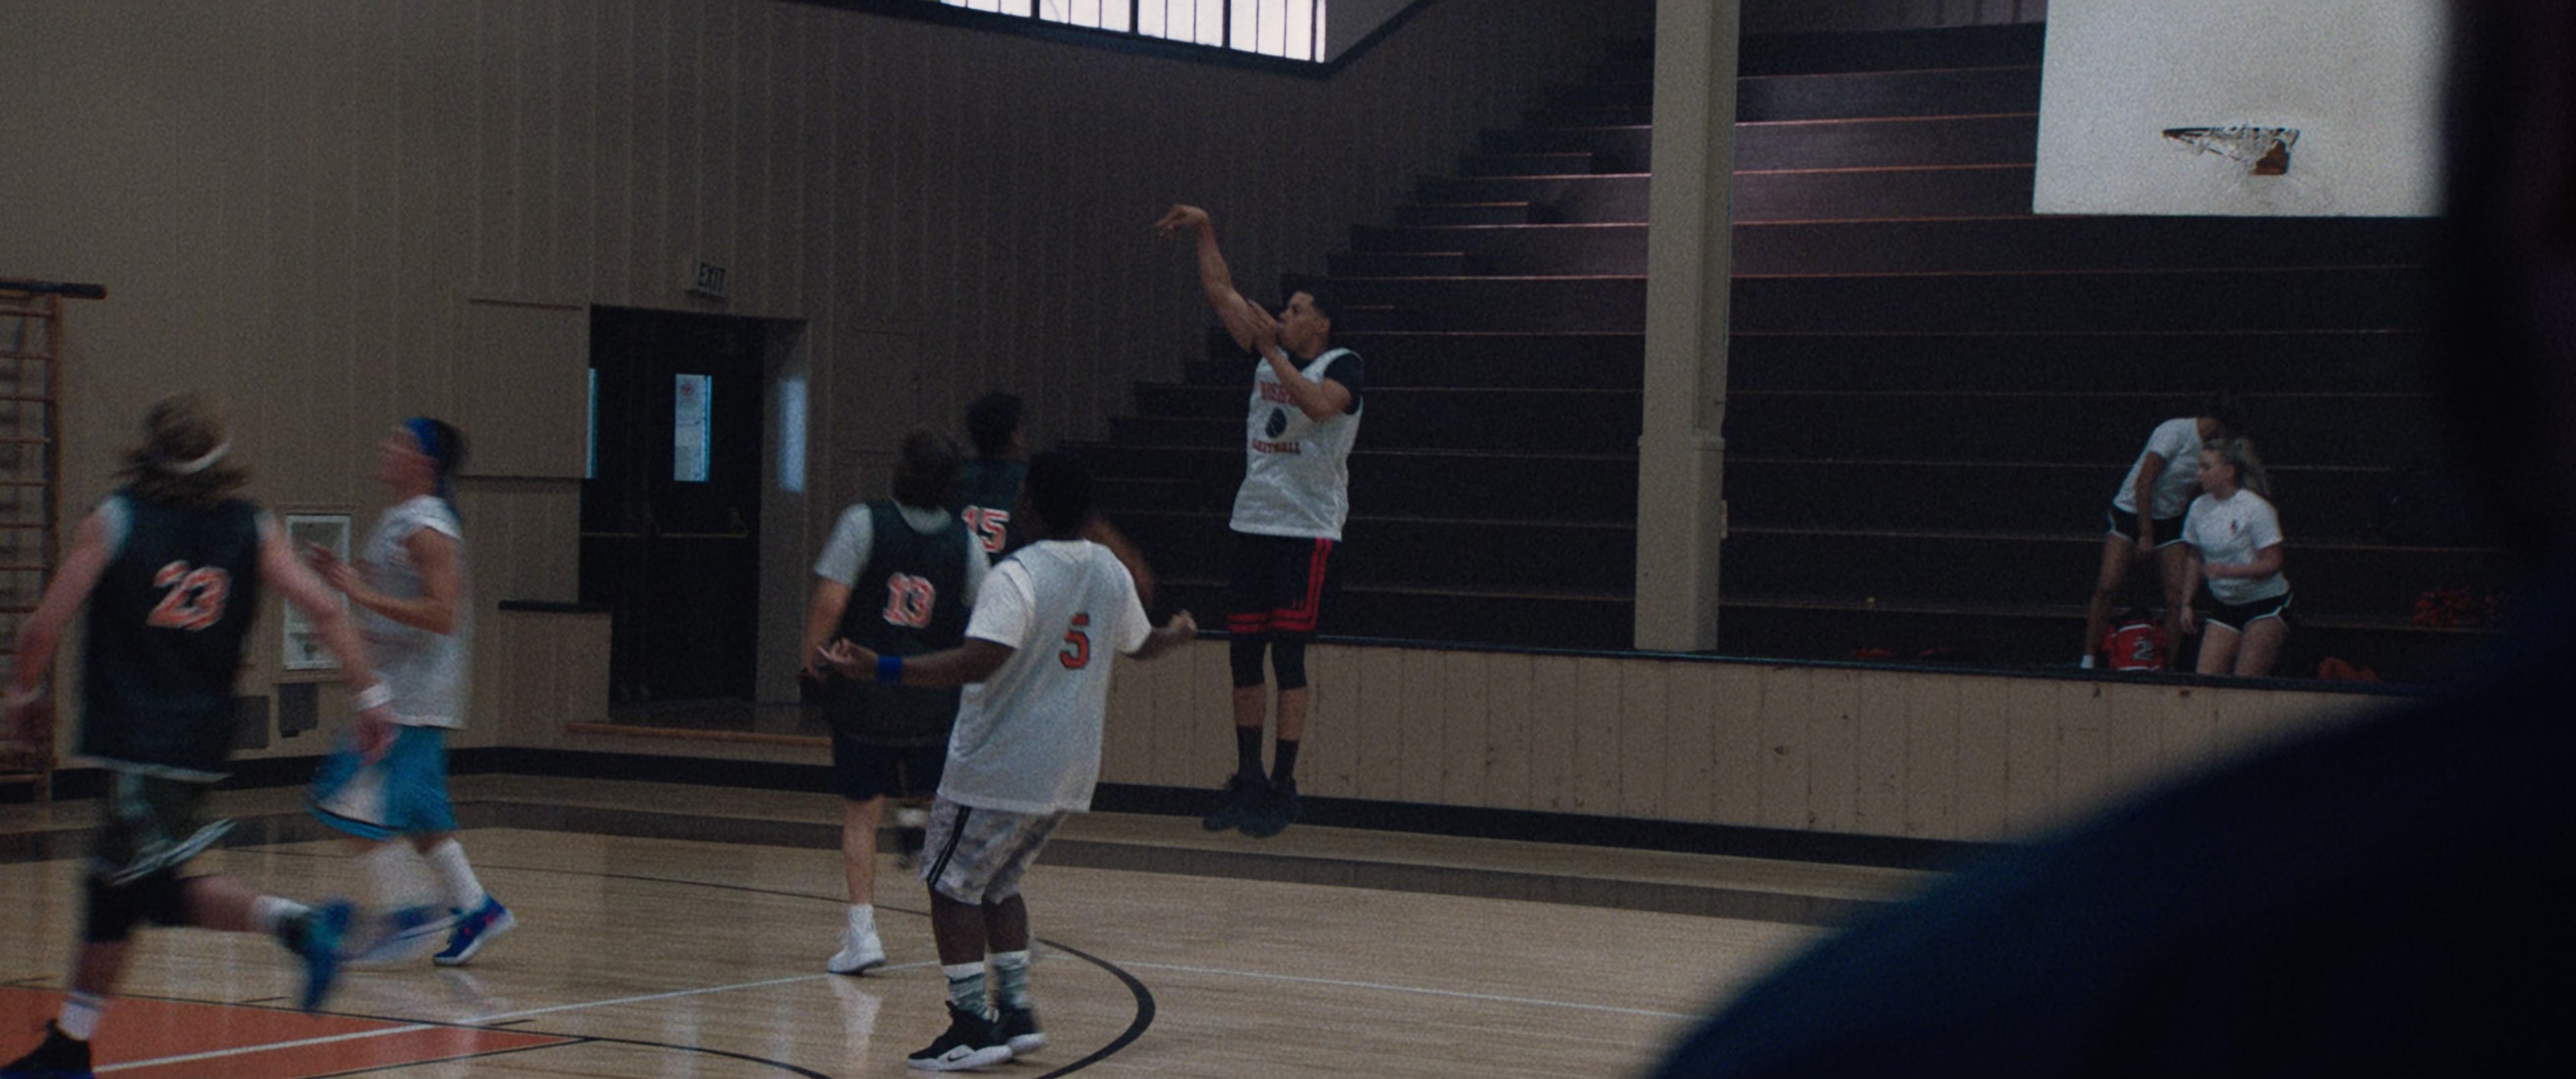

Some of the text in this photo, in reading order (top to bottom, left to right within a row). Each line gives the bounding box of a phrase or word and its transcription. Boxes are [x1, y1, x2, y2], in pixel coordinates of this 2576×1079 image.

[698, 262, 726, 292] EXIT
[961, 505, 1010, 553] 15
[144, 560, 232, 631] 23
[882, 572, 936, 629] 13
[1059, 613, 1090, 669] 5
